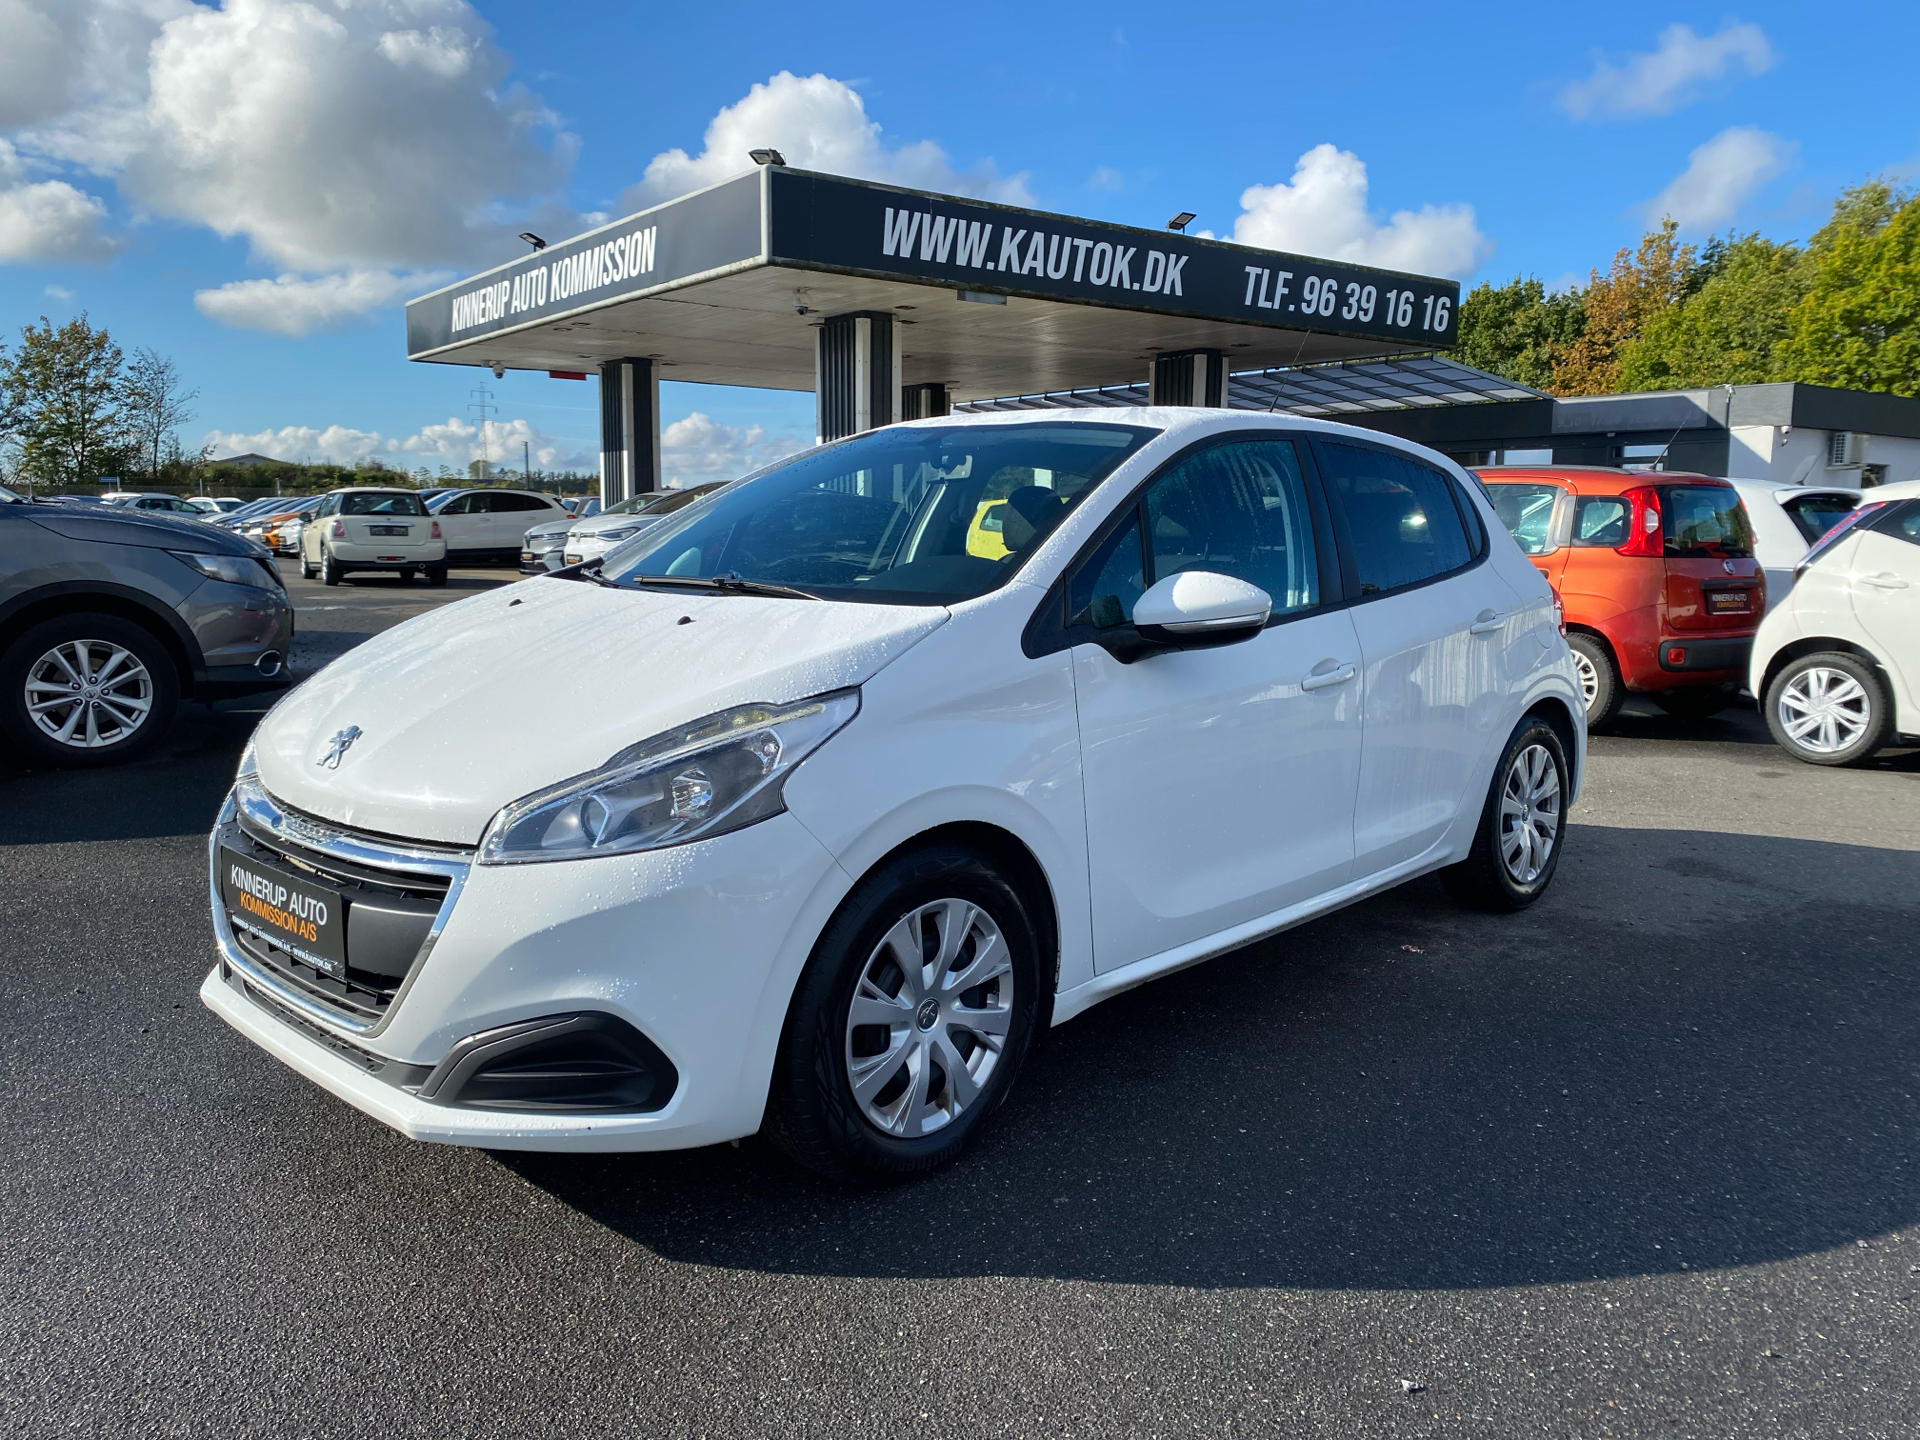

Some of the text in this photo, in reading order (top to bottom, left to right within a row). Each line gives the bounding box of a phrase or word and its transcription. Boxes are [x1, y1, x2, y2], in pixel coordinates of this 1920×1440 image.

[452, 226, 657, 332] KINNERUP AUTO KOMMISSION
[882, 207, 1189, 297] WWW.KAUTOK.DK
[1303, 275, 1337, 317] 96
[1342, 282, 1377, 322] 39
[1386, 288, 1415, 328] 16
[1422, 295, 1451, 333] 16
[231, 864, 328, 926] KINNERUP AUTO
[240, 891, 298, 934] KOMMISSION
[299, 919, 317, 942] A/S
